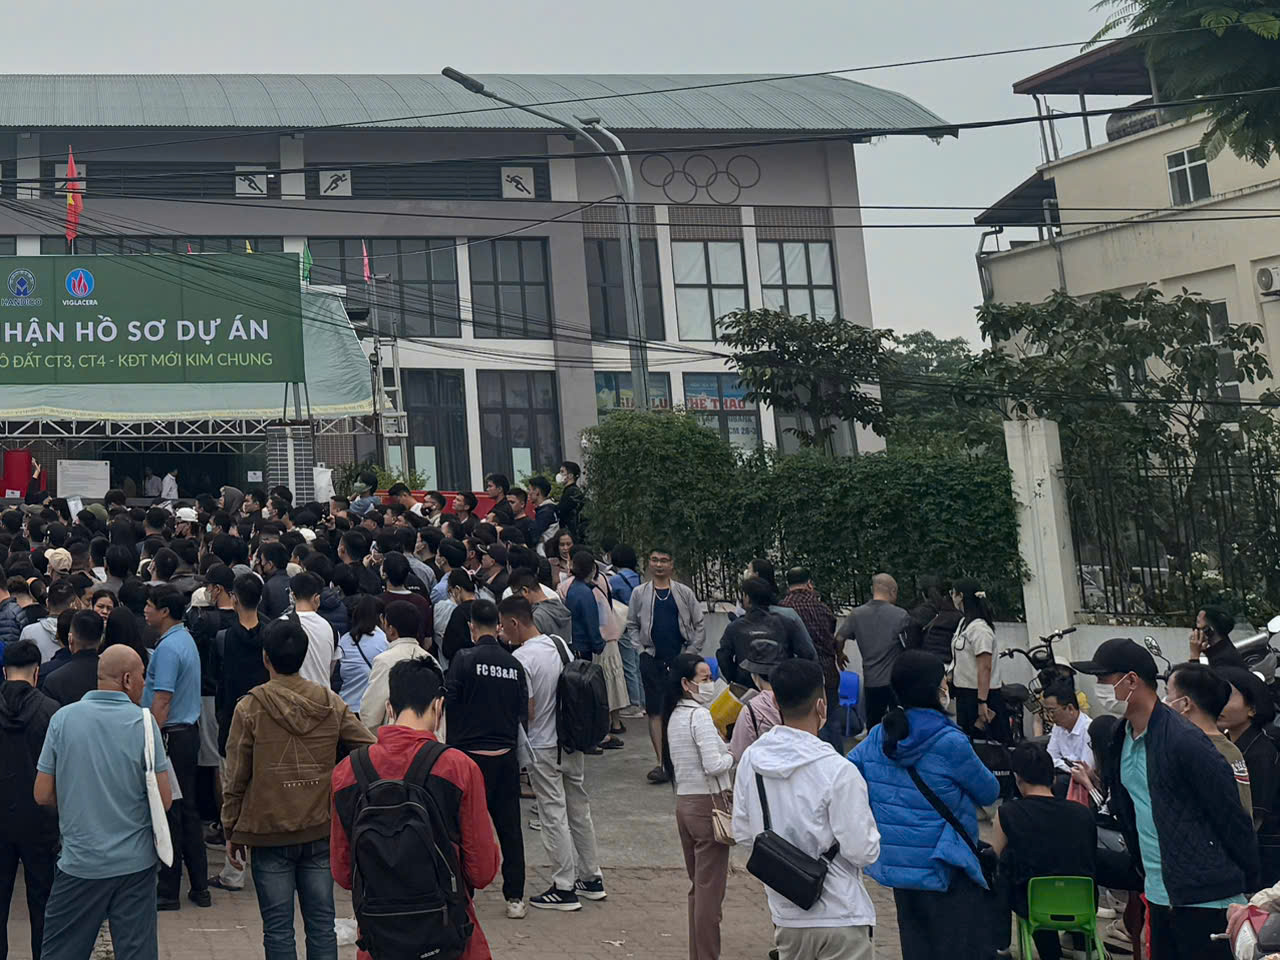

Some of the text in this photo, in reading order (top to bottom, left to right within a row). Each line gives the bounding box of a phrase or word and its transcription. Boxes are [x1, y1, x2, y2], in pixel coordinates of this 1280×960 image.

[0, 298, 42, 307] HANDICO
[76, 314, 118, 343] HỒ
[127, 318, 166, 342] SƠ
[177, 318, 221, 346] DỰ
[228, 314, 269, 341] ÁN
[12, 351, 41, 368] ĐẤT
[44, 355, 75, 370] CT3,
[78, 354, 106, 368] CT4
[118, 354, 148, 368] KĐT
[151, 350, 181, 367] MỚI
[186, 353, 213, 367] KIM
[217, 352, 273, 367] CHUNG
[476, 663, 489, 676] FC
